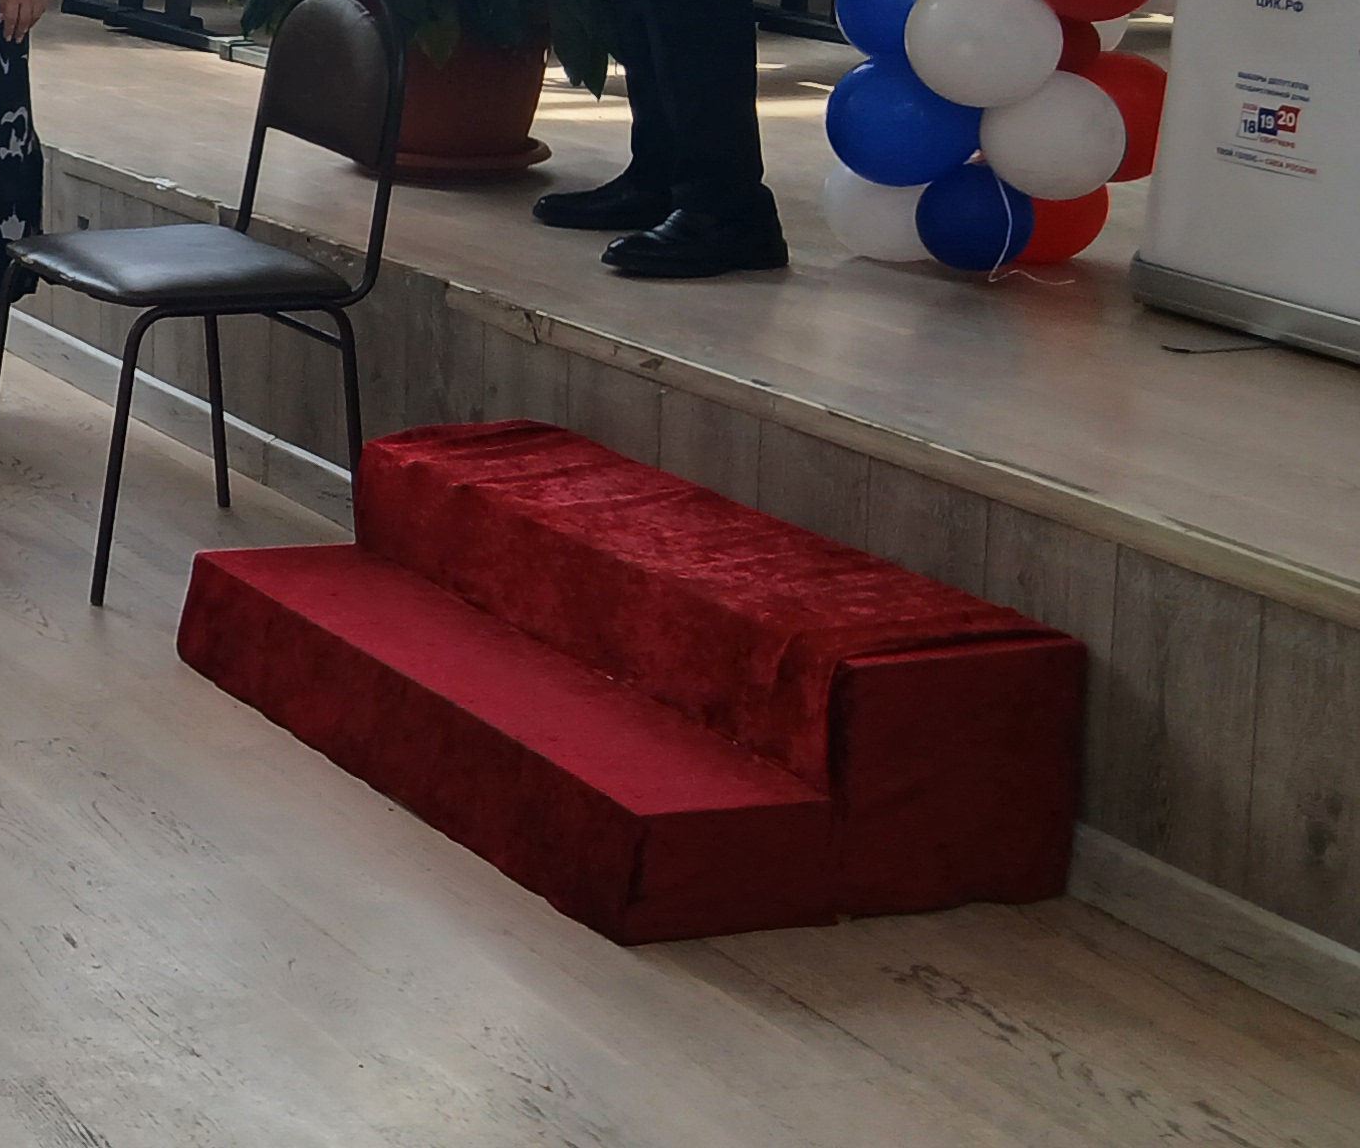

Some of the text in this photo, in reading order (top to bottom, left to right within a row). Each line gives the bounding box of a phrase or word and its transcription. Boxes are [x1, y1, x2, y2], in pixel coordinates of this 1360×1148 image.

[1242, 110, 1295, 134] 18 19 20
